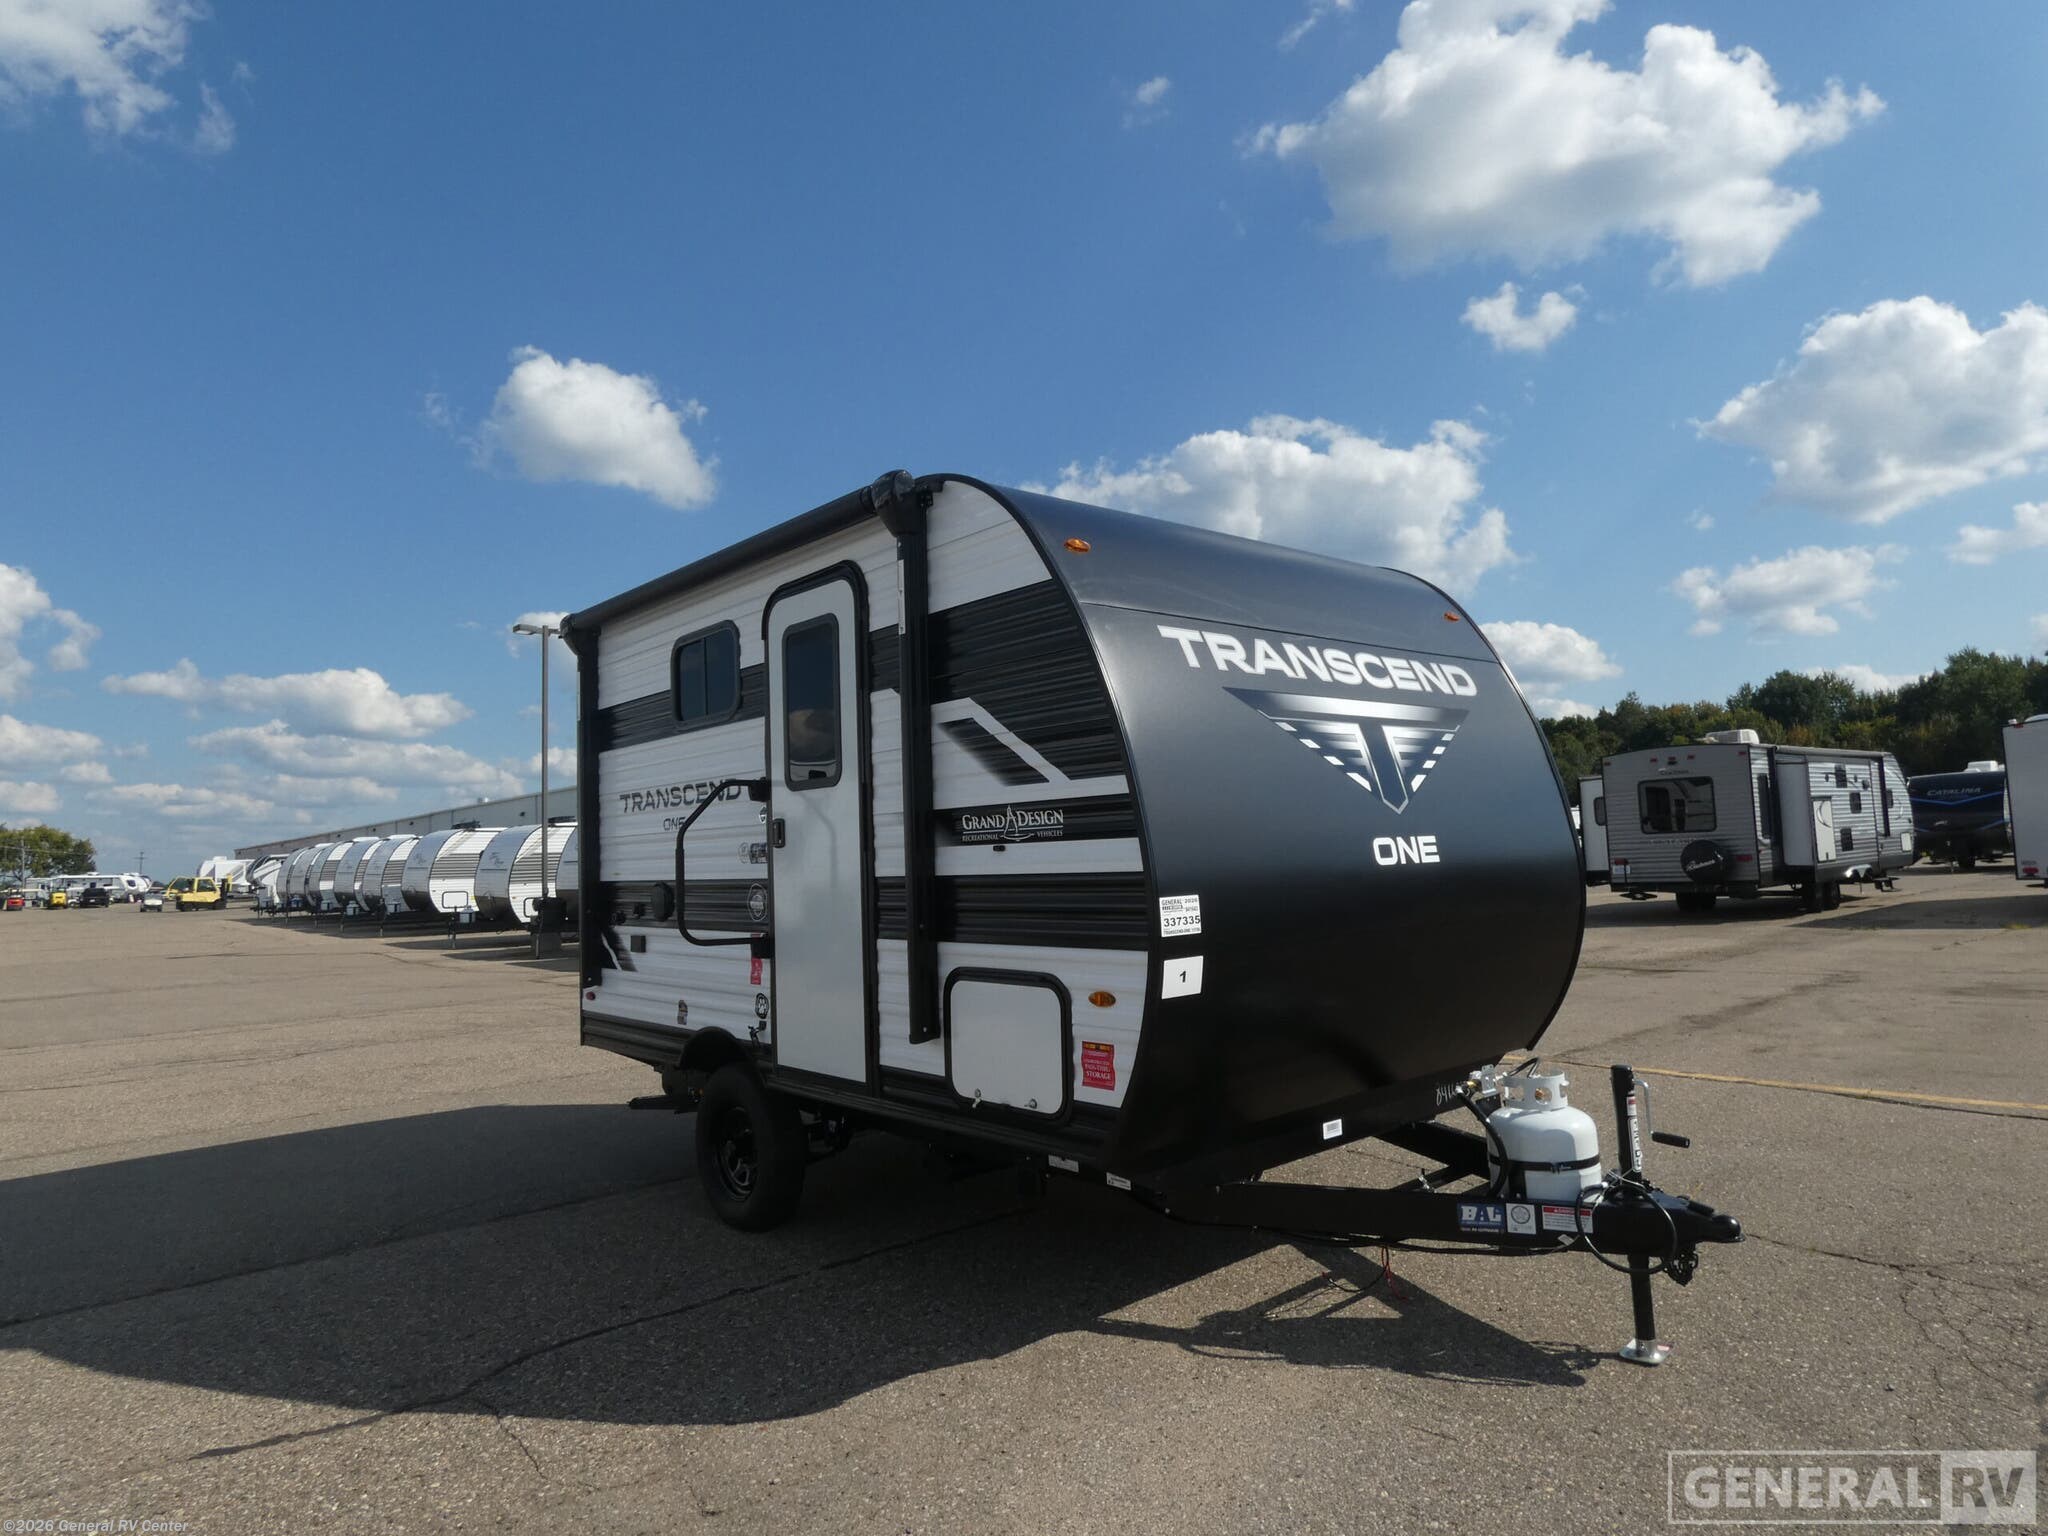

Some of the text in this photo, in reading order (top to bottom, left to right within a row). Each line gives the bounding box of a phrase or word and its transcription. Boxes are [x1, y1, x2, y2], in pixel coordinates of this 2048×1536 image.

[1157, 625, 1477, 697] TRANSCEND
[619, 779, 742, 813] TRANSCEND
[962, 809, 1064, 830] GRAND DESIGN
[962, 830, 1063, 842] RECREATIONAL VEHICLES
[1372, 835, 1441, 866] ONE
[1163, 915, 1201, 927] 337335
[1179, 970, 1187, 983] 1
